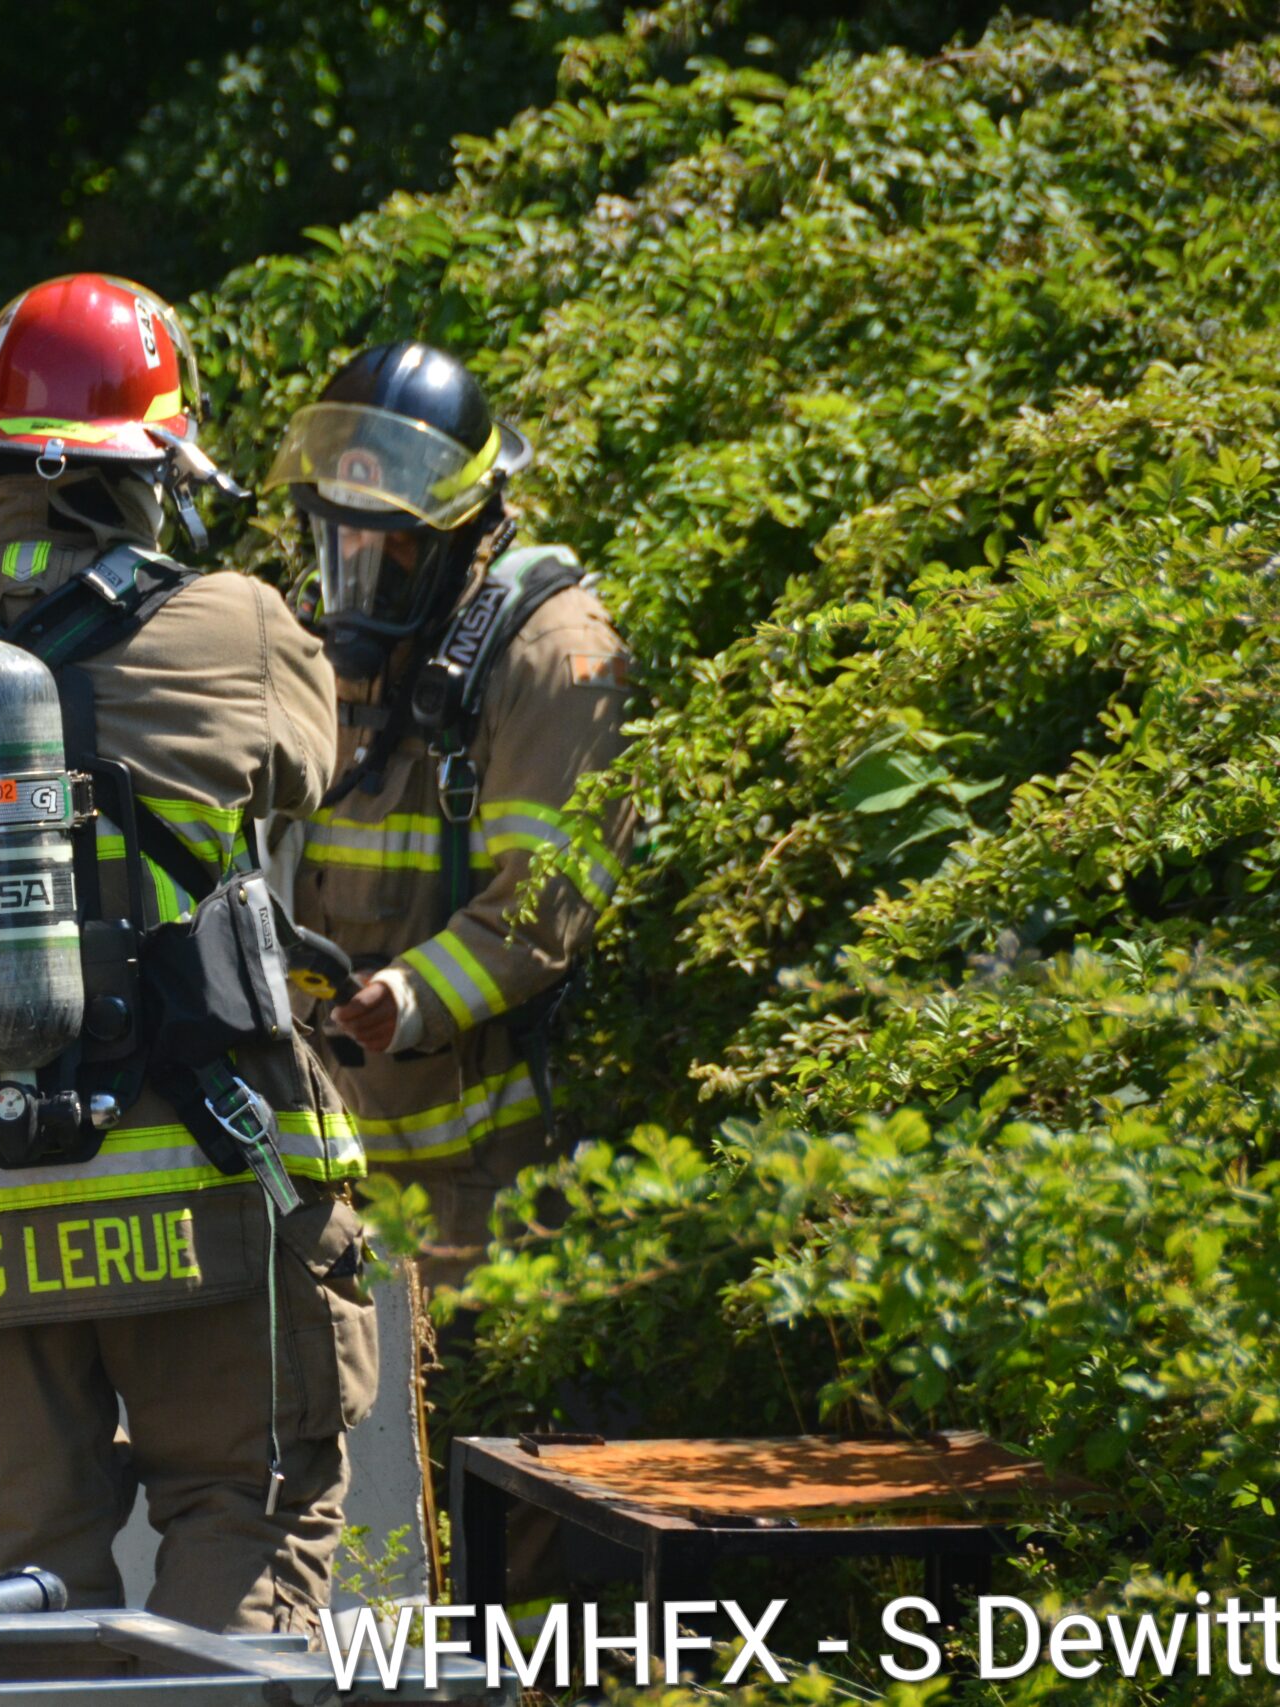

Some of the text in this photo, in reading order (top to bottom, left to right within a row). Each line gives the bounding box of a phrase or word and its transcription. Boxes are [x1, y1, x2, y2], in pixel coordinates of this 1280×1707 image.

[448, 586, 509, 664] MSA
[259, 906, 273, 950] MSA
[23, 1208, 200, 1293] LERUE
